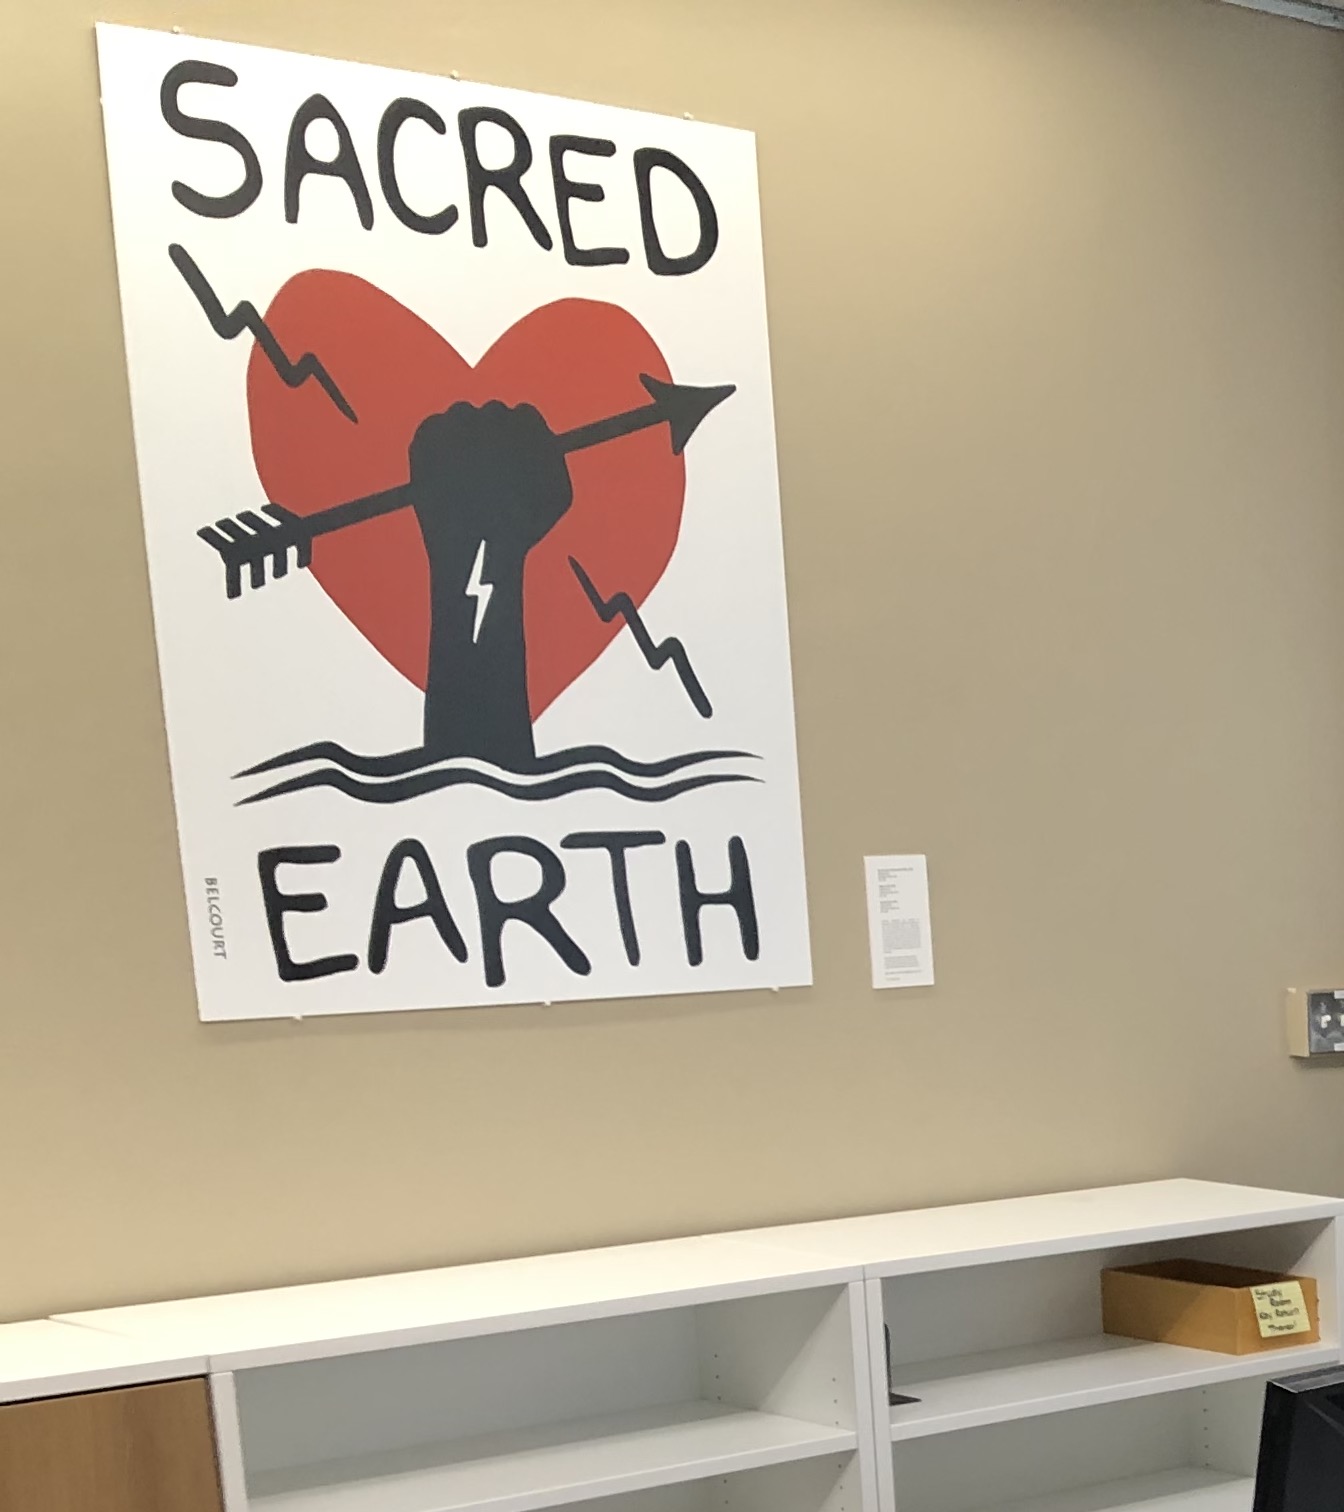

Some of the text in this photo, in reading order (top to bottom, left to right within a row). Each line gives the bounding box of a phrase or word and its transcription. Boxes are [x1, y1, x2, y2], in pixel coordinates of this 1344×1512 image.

[160, 59, 719, 276] SACRED
[204, 877, 227, 960] BELCOURT
[257, 831, 760, 988] EARTH
